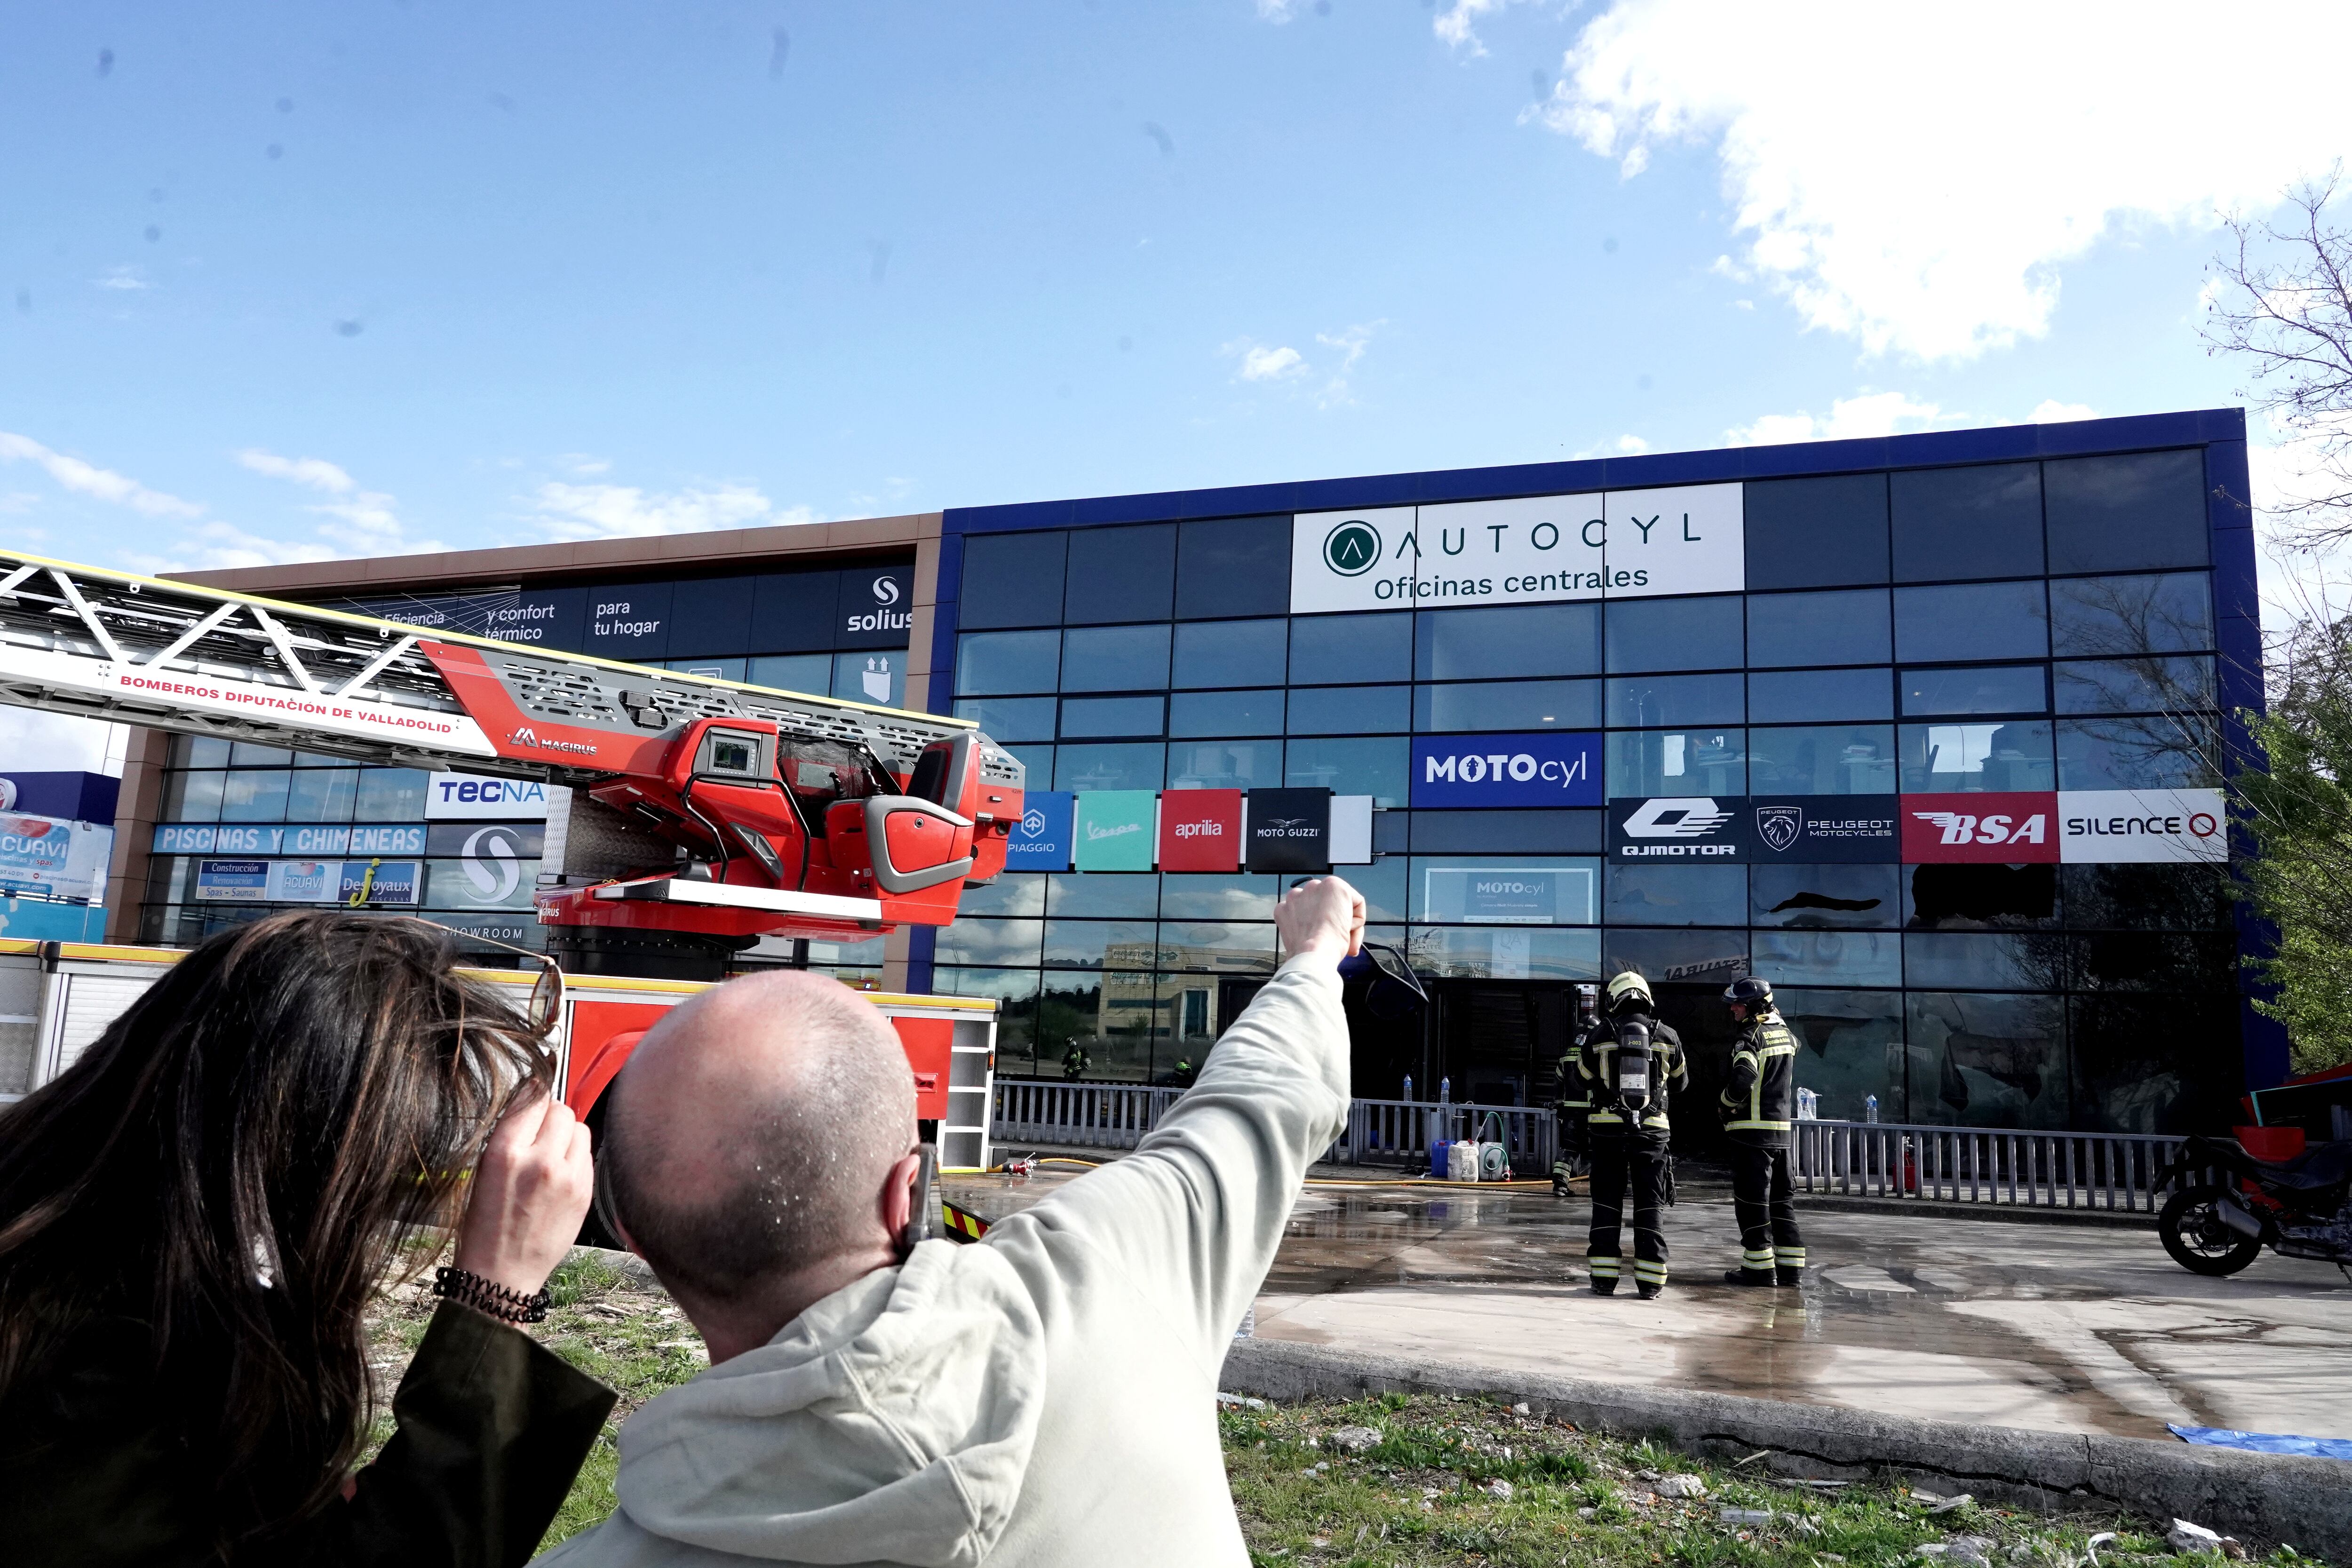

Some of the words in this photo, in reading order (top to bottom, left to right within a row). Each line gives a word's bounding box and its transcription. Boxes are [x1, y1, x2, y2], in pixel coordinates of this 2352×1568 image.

[1395, 512, 1701, 560] AUTOCYL
[1375, 575, 1493, 600] Oficinas
[1503, 565, 1648, 593] centrales
[385, 613, 445, 625] Eficiencia
[486, 608, 496, 625] y
[499, 604, 555, 621] confort
[596, 602, 630, 619] para
[594, 621, 610, 636] tu
[613, 619, 660, 639] hogar
[847, 609, 912, 631] solius
[485, 627, 542, 641] térmico
[119, 675, 220, 699] BOMBEROS
[225, 691, 327, 715] DIPUTACIÓN
[332, 707, 352, 719] DE
[359, 710, 452, 733] VALLADOLID
[540, 738, 597, 756] MAGIRUS
[1426, 751, 1587, 788] MOTOcyl
[1088, 820, 1142, 841] Vespa
[1175, 819, 1222, 839] aprilia
[1257, 828, 1285, 838] MOTO
[1287, 828, 1319, 837] GUZZI
[1807, 820, 1894, 829] PEUGEOT
[1940, 814, 2046, 844] BSA
[2067, 816, 2182, 836] SILENCE
[0, 836, 67, 859] CUAVI
[162, 828, 259, 851] PISCINAS
[270, 829, 284, 850] Y
[297, 828, 421, 852] CHIMENEAS
[1008, 844, 1055, 853] PIAGGIO
[1622, 844, 1736, 856] QJMOTOR
[212, 862, 259, 873] Construcción
[213, 875, 253, 885] Renovación
[283, 876, 325, 889] ACUAVI
[1477, 881, 1544, 896] MOTOcyl
[206, 887, 223, 898] Spas
[231, 887, 256, 898] Saunas
[441, 927, 523, 939] SHOWROOM
